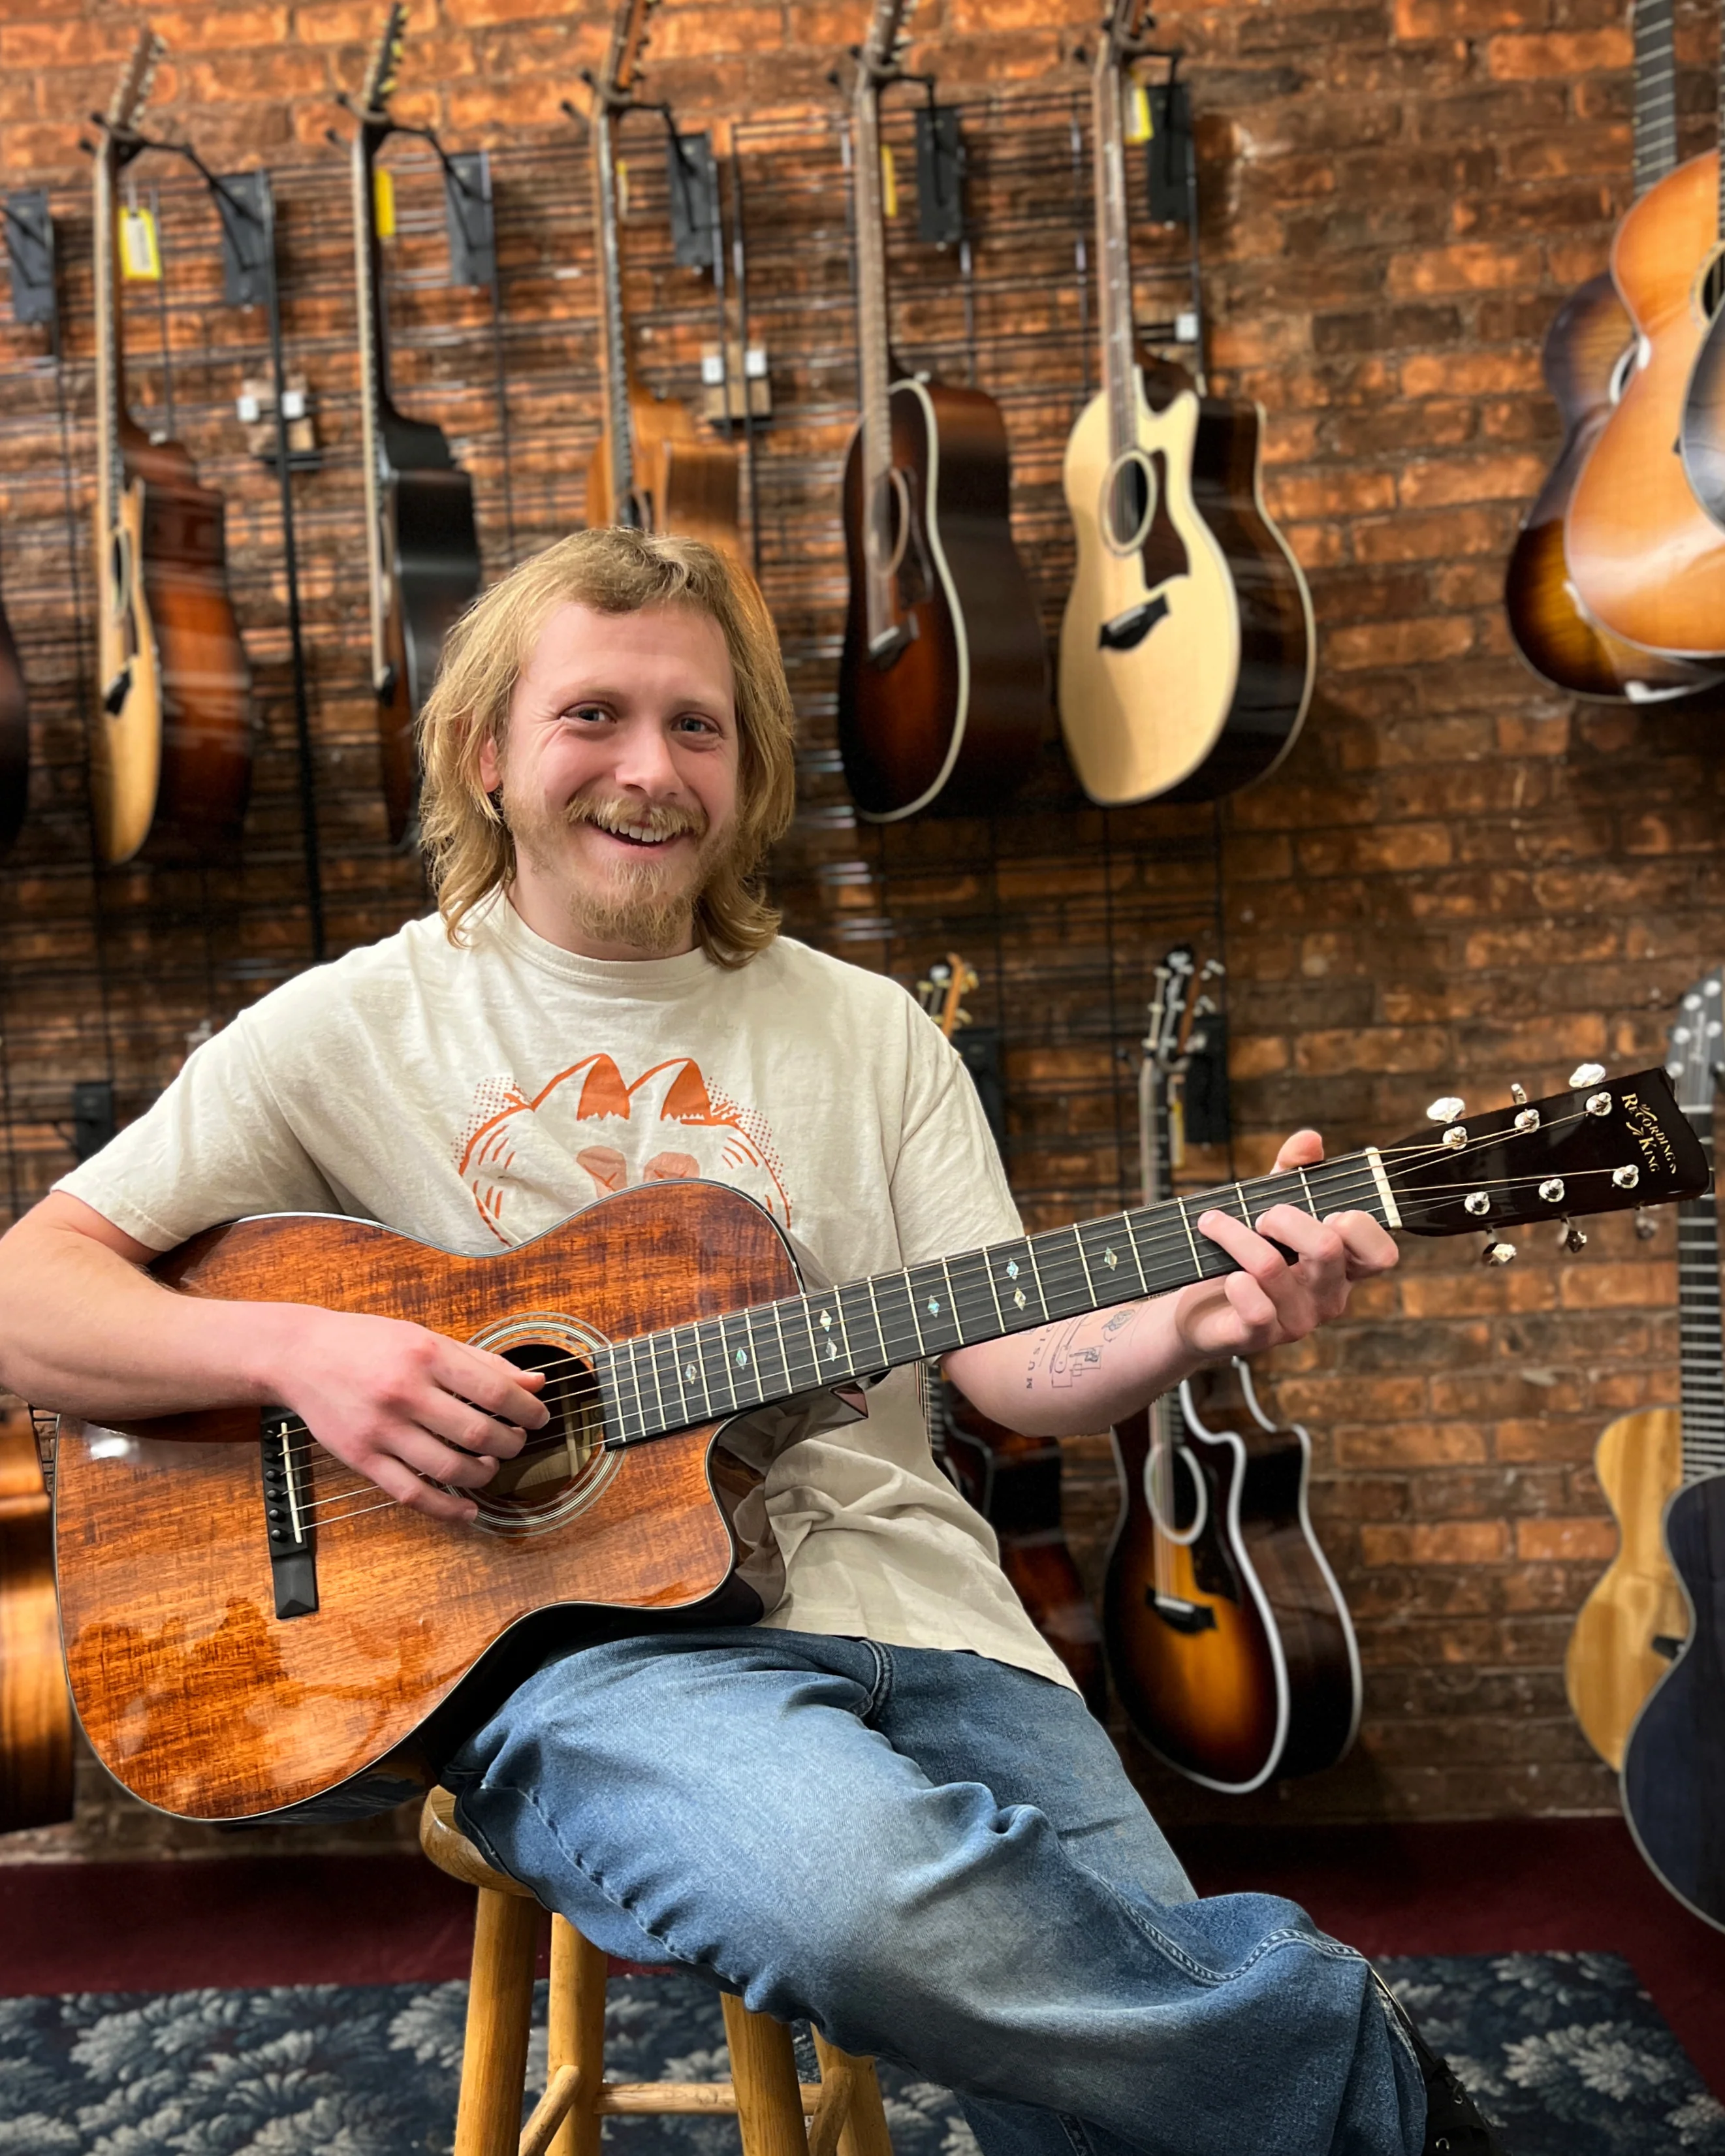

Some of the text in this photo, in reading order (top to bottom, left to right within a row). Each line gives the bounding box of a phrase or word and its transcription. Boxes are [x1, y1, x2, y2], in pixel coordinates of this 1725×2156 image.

[1621, 1093, 1676, 1161] RECORDING
[1638, 1137, 1660, 1172] KING
[1026, 1325, 1054, 1389] MUSIC
